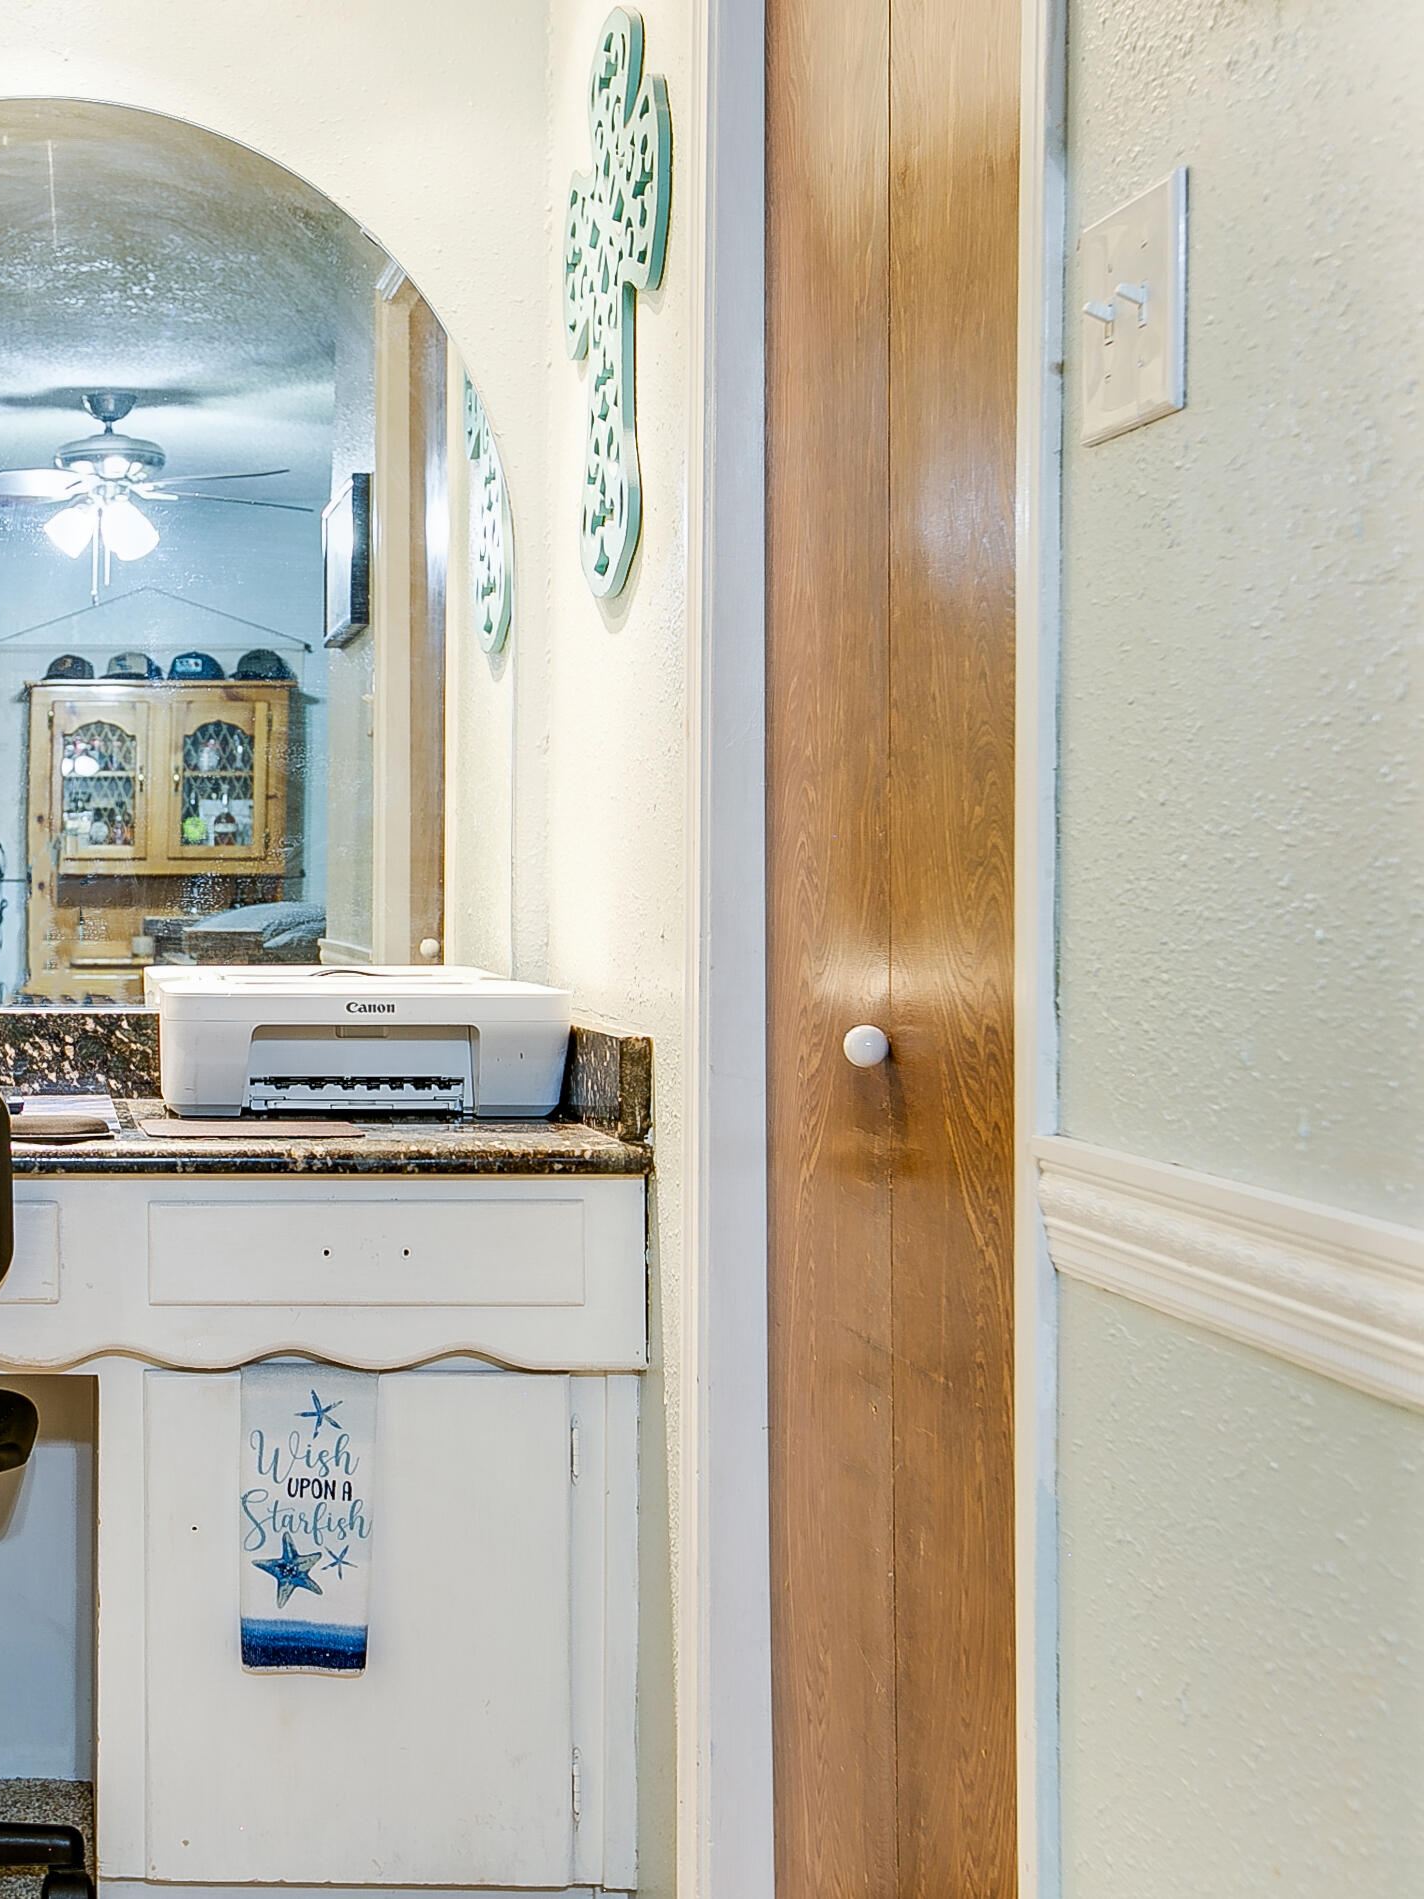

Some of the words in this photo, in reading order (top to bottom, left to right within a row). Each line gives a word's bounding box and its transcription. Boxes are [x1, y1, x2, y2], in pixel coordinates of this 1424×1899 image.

[345, 1001, 396, 1015] Canon
[250, 1429, 360, 1485] Wish
[287, 1477, 336, 1501] UPON
[342, 1480, 353, 1502] A
[241, 1488, 373, 1552] Starfish
